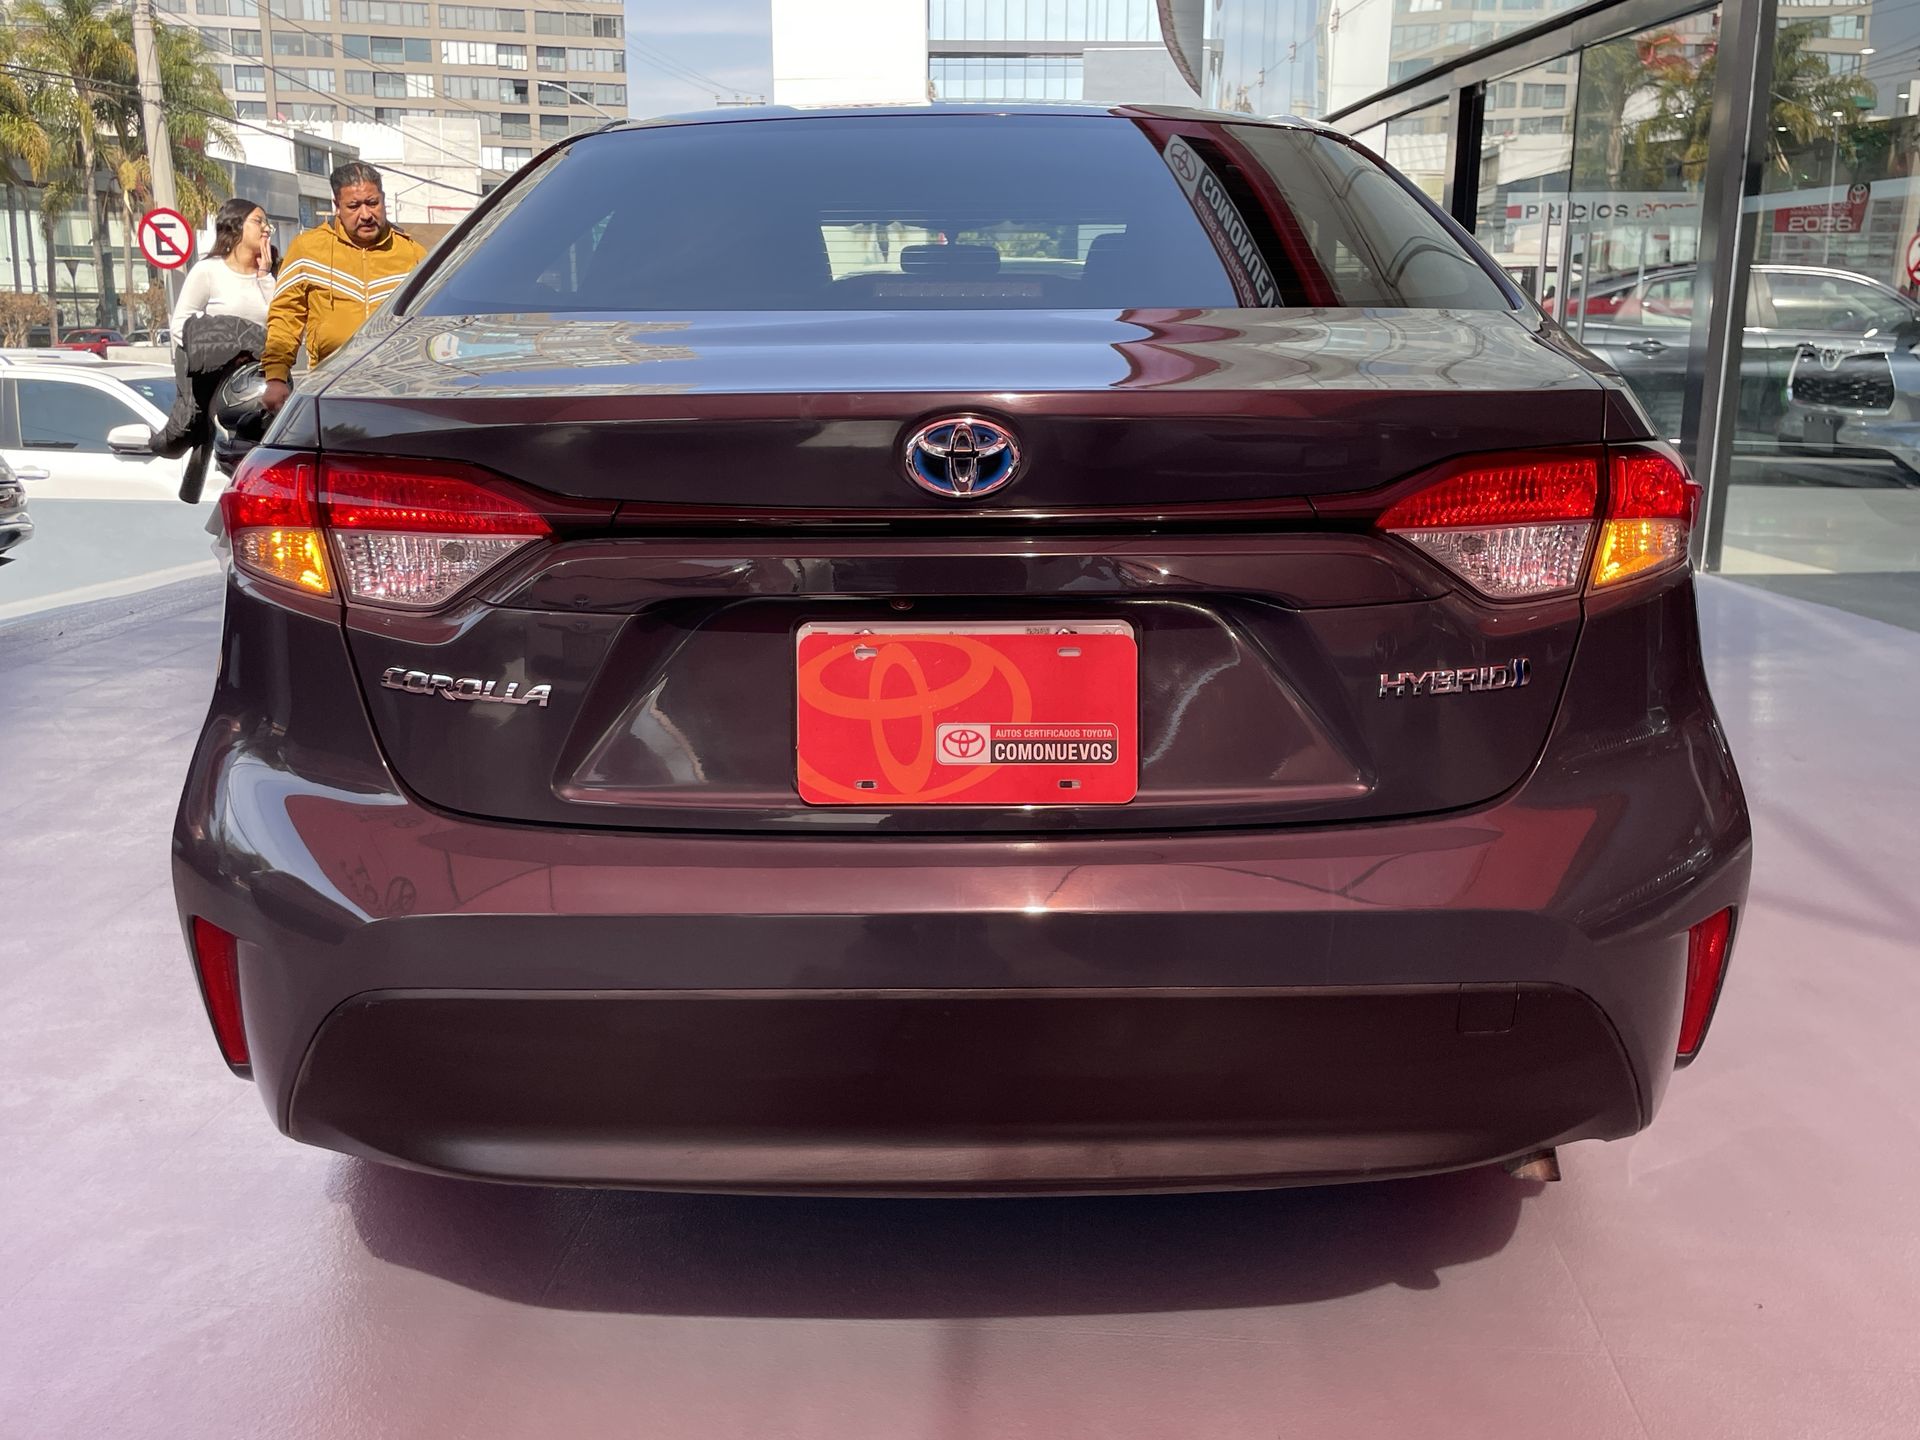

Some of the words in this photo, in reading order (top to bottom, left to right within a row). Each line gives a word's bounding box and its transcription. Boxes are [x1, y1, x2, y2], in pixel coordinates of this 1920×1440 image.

[1788, 216, 1853, 232] 2026
[154, 223, 178, 256] E
[381, 667, 552, 707] COROLLA
[1378, 664, 1510, 698] HYBRID
[995, 729, 1022, 738] AUTOS
[1024, 729, 1081, 738] CERTIFICADOS
[1082, 729, 1113, 738] TOYOTA
[994, 743, 1113, 761] COMONUEVOS
